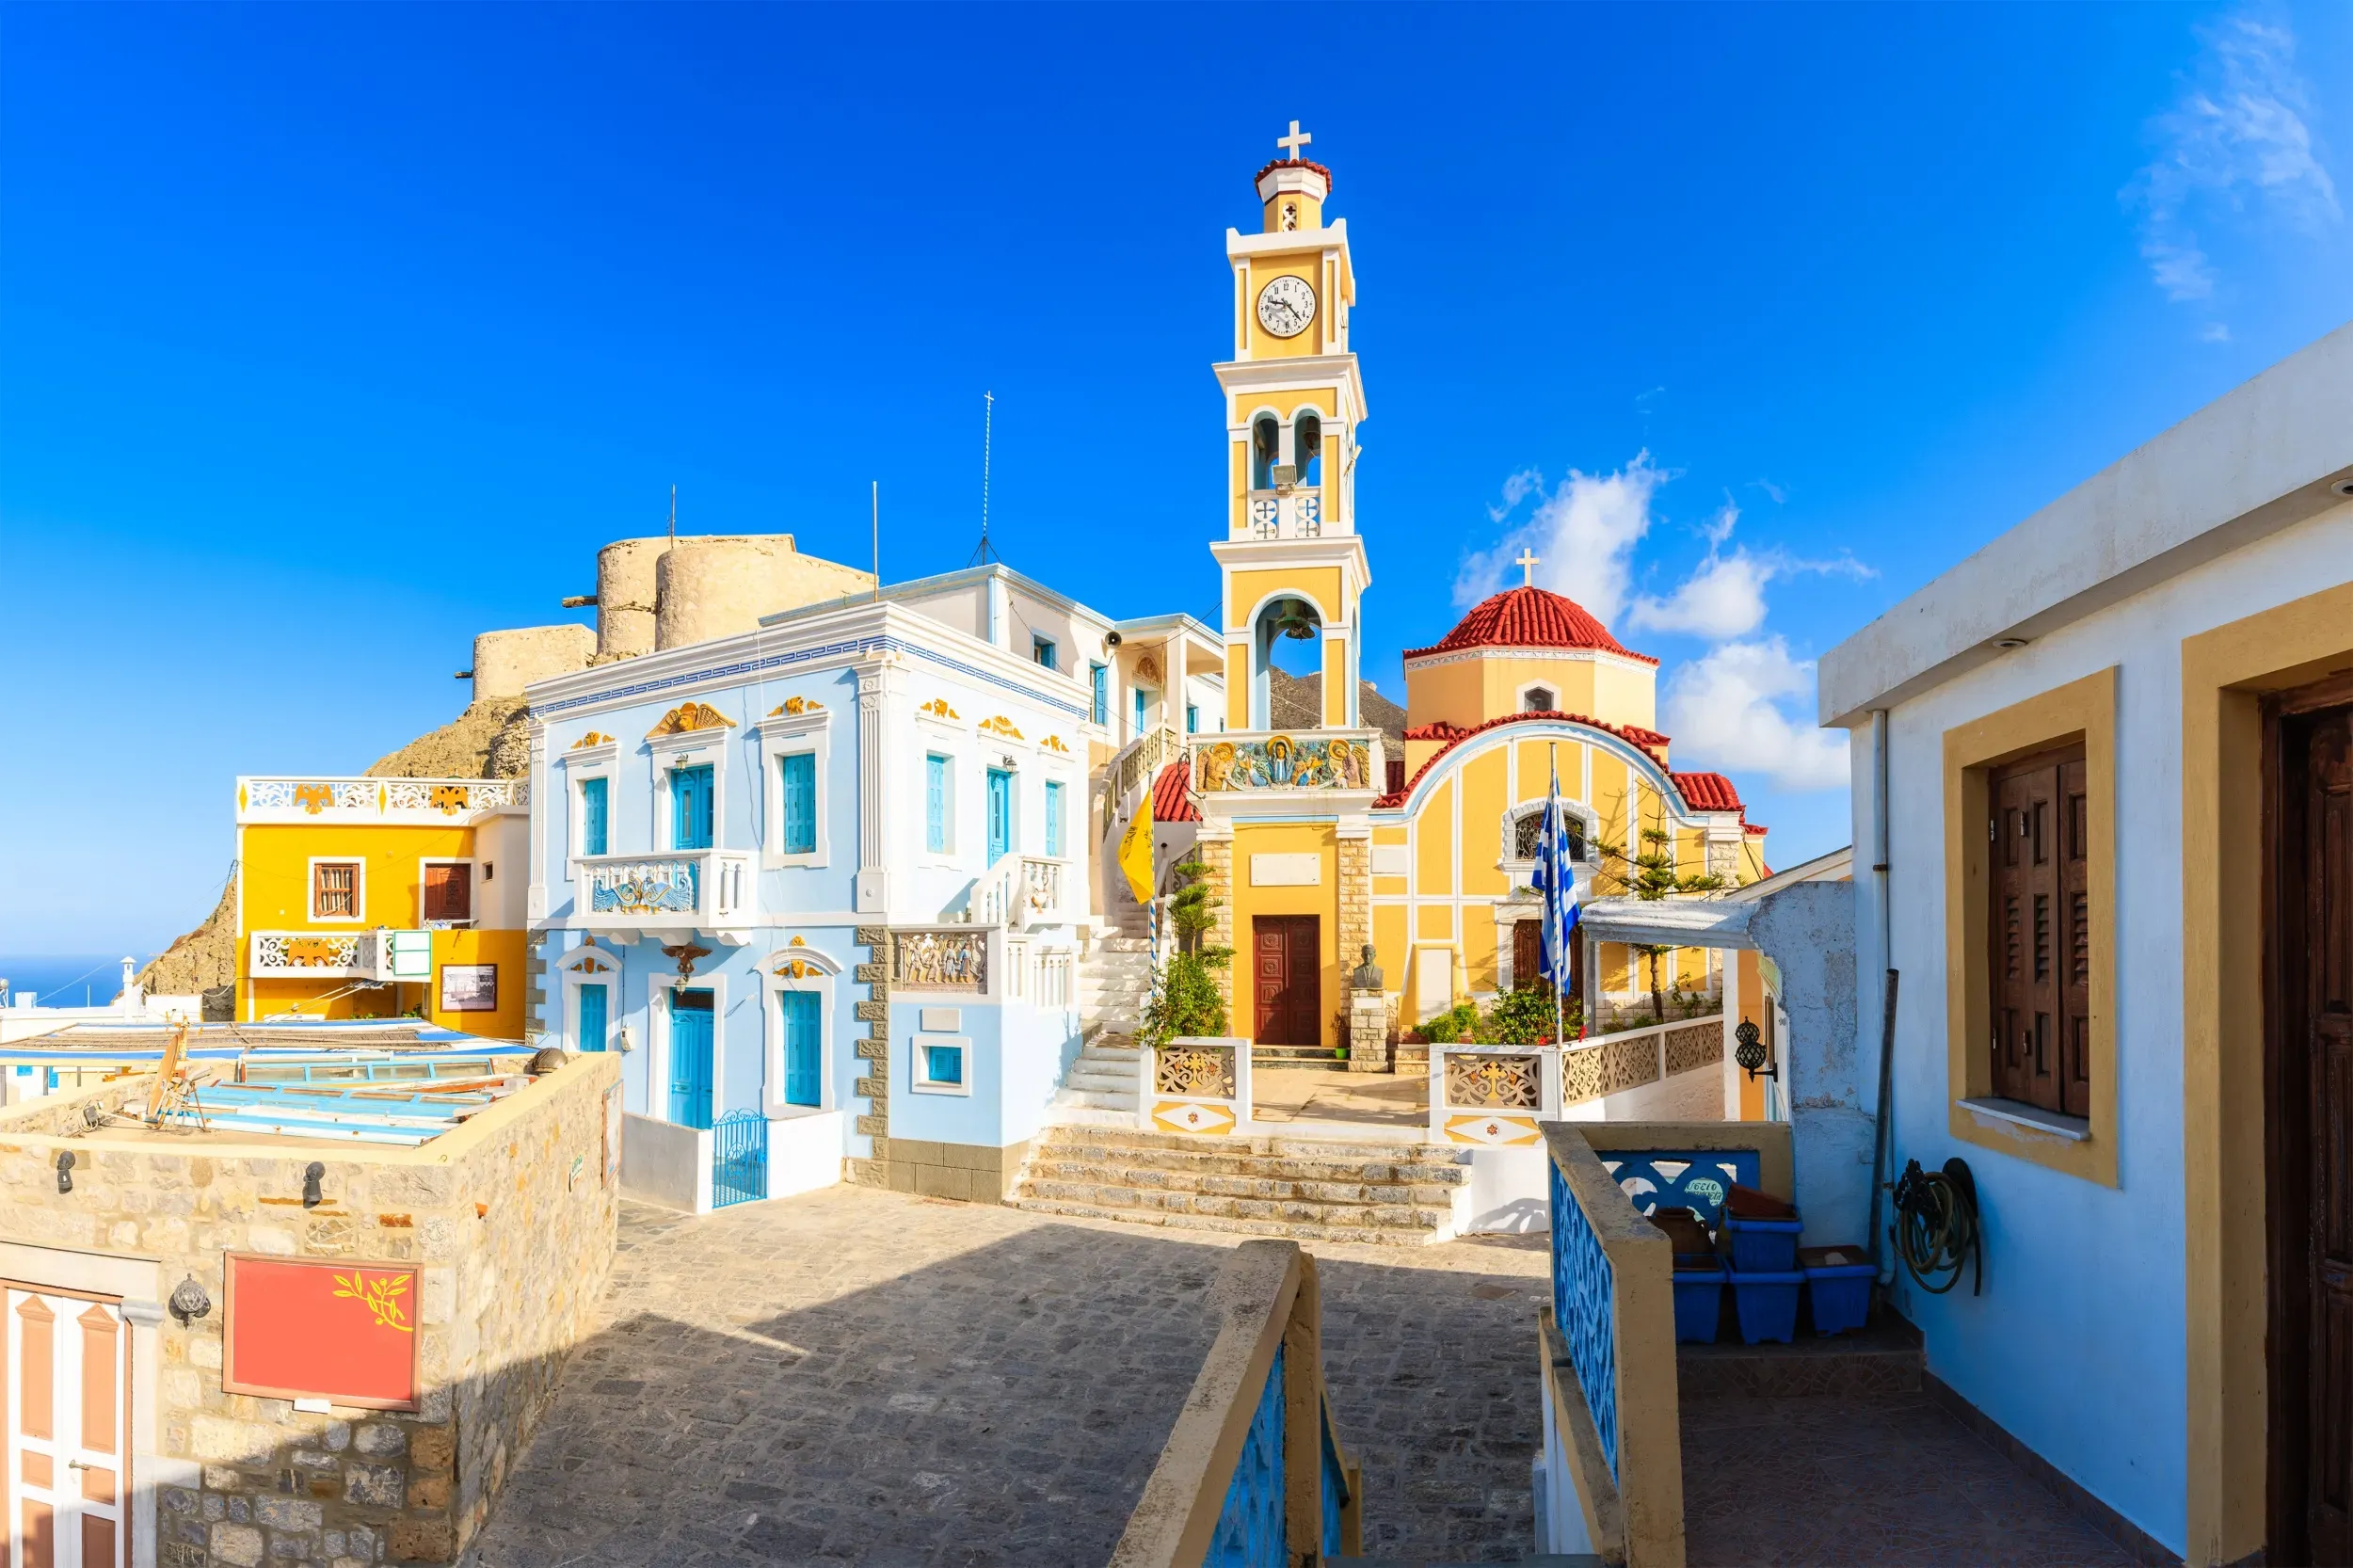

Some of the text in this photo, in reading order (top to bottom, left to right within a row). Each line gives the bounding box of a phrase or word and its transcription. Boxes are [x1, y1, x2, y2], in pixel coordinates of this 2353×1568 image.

[1267, 295, 1273, 303] 10
[1276, 320, 1280, 328] 7
[1285, 321, 1289, 329] 6
[1294, 319, 1298, 327] 5
